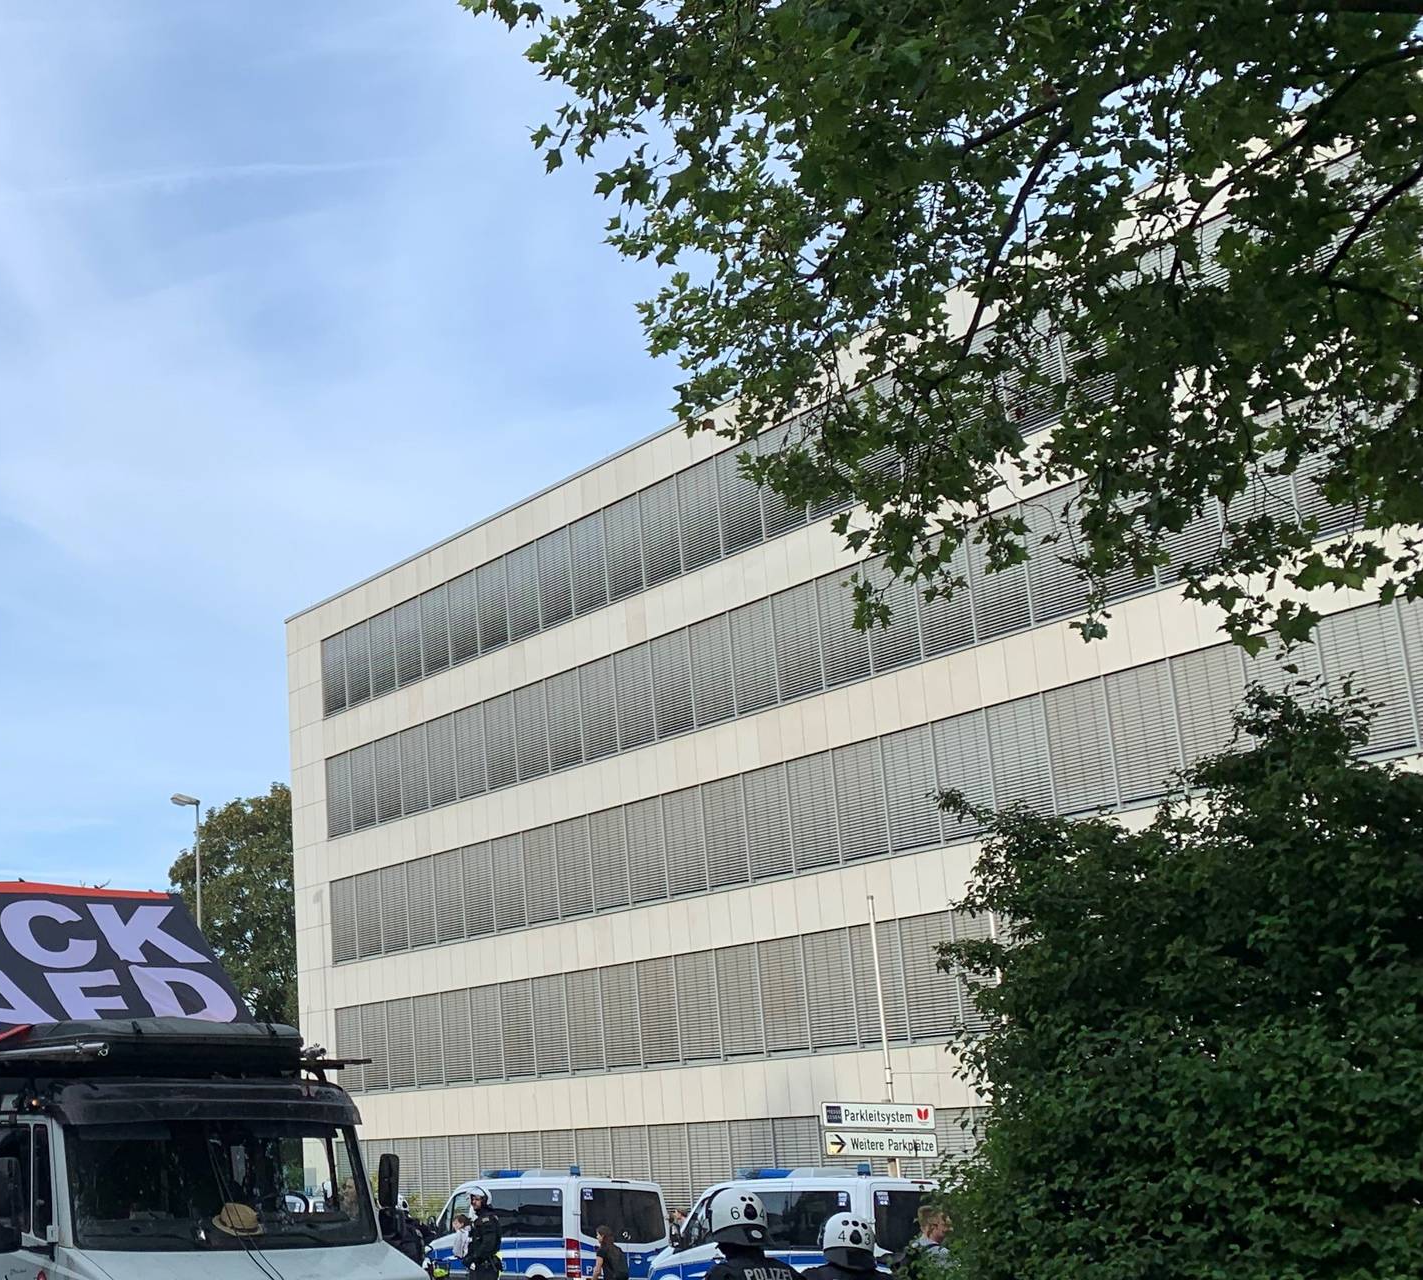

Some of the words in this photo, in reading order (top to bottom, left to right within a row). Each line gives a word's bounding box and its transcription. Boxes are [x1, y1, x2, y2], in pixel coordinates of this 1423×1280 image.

[845, 1109, 913, 1125] Parkleitsystem
[850, 1137, 884, 1151] Weitere
[730, 1206, 740, 1220] 6
[837, 1230, 846, 1242] 4
[864, 1232, 871, 1246] 3
